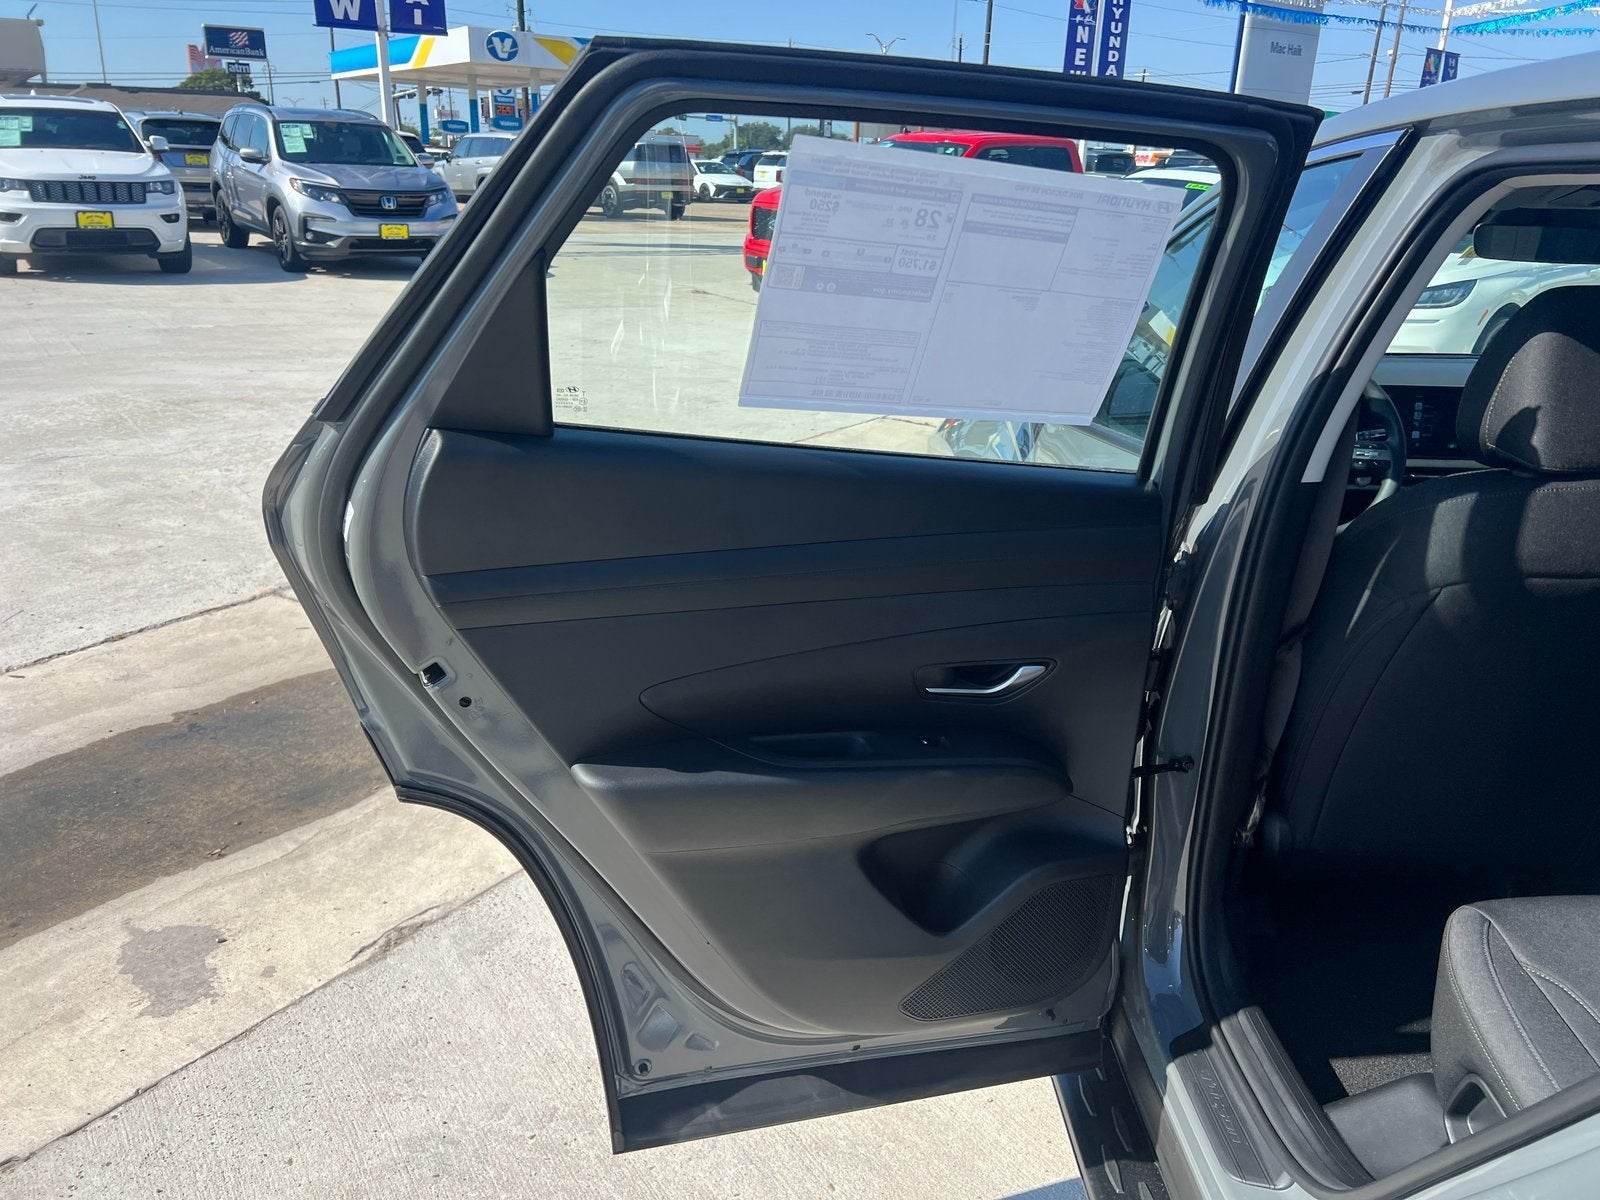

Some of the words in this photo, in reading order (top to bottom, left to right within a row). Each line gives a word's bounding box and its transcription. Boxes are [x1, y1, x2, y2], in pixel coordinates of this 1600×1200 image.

[1069, 25, 1090, 76] NE
[1270, 41, 1286, 54] Mac
[1287, 44, 1302, 56] Haik
[228, 63, 250, 73] atm
